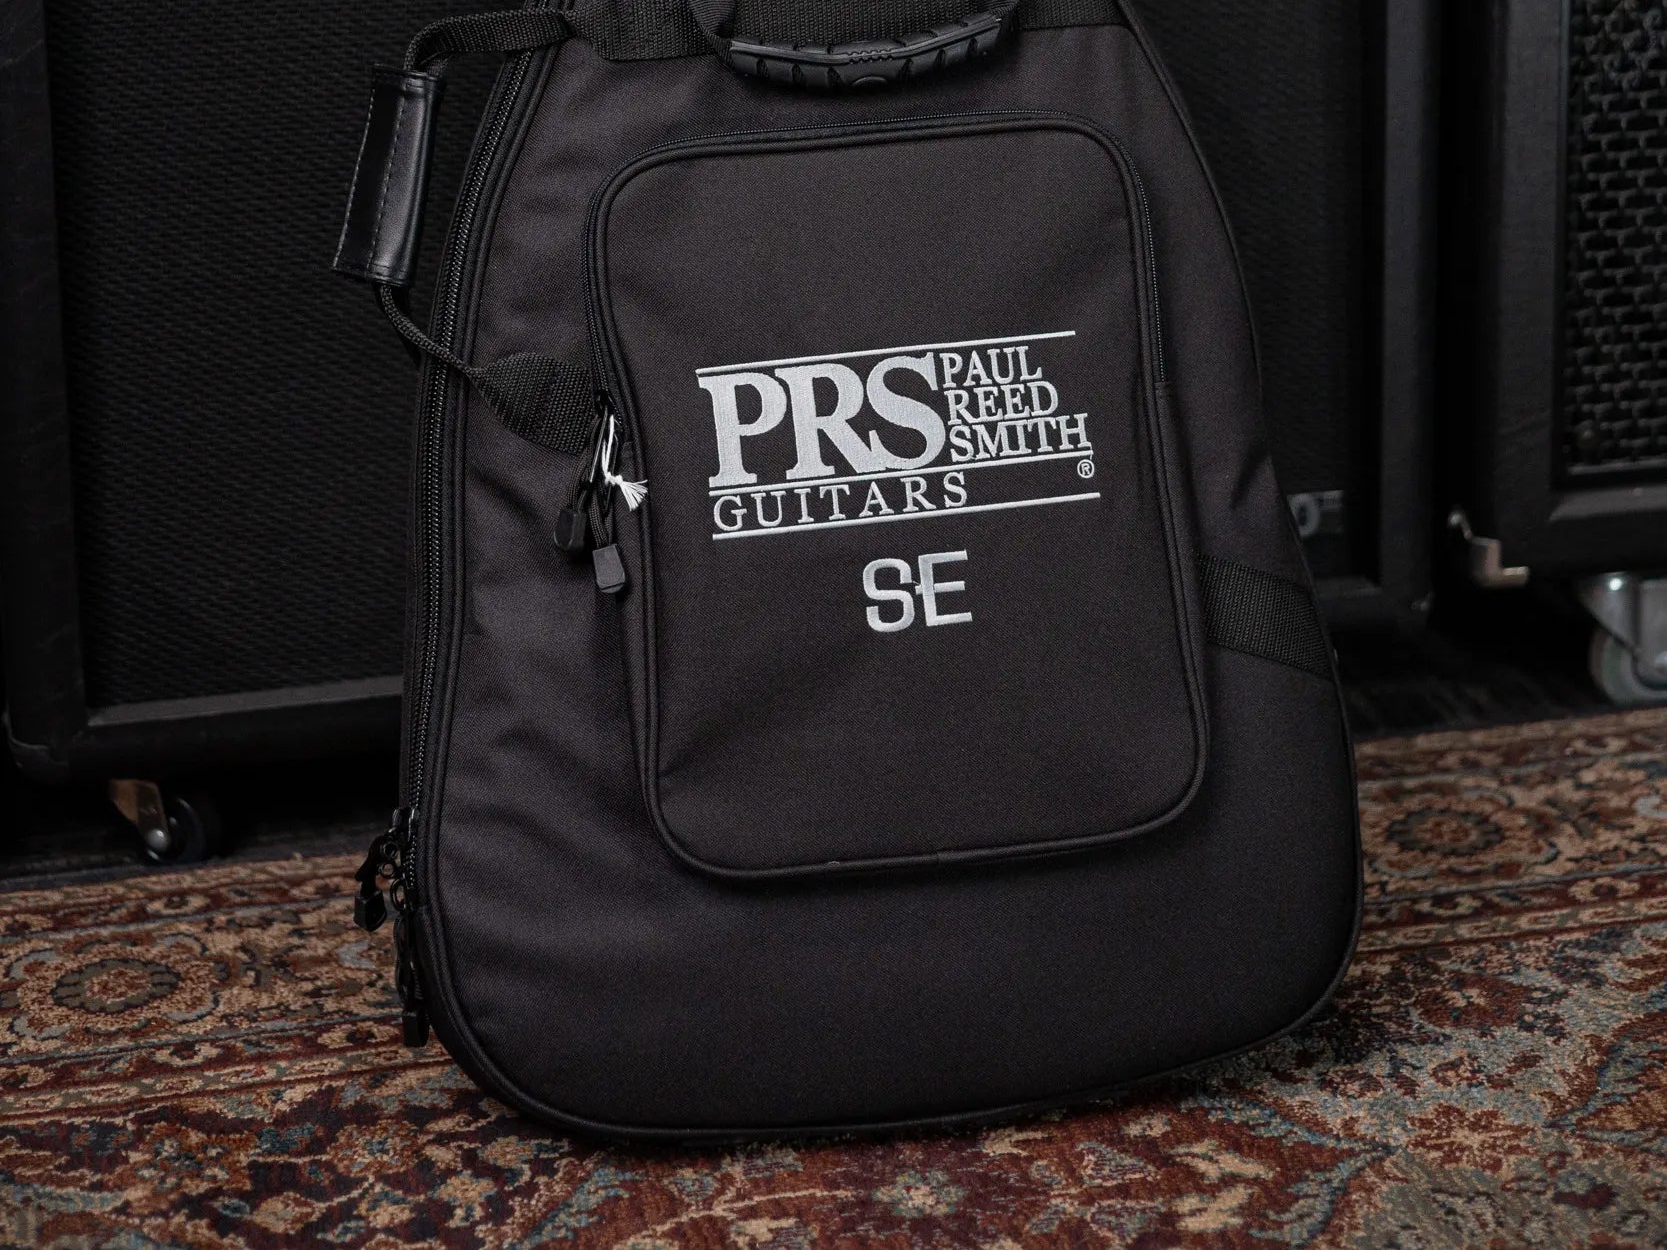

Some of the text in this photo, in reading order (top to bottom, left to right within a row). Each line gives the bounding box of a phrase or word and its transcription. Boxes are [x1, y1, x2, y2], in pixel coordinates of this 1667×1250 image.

[940, 346, 1042, 388] PAUL
[699, 352, 946, 487] PRS
[945, 381, 1058, 425] REED
[948, 413, 1092, 462] SMITH
[713, 472, 968, 531] GUITARS
[862, 550, 973, 633] SE
